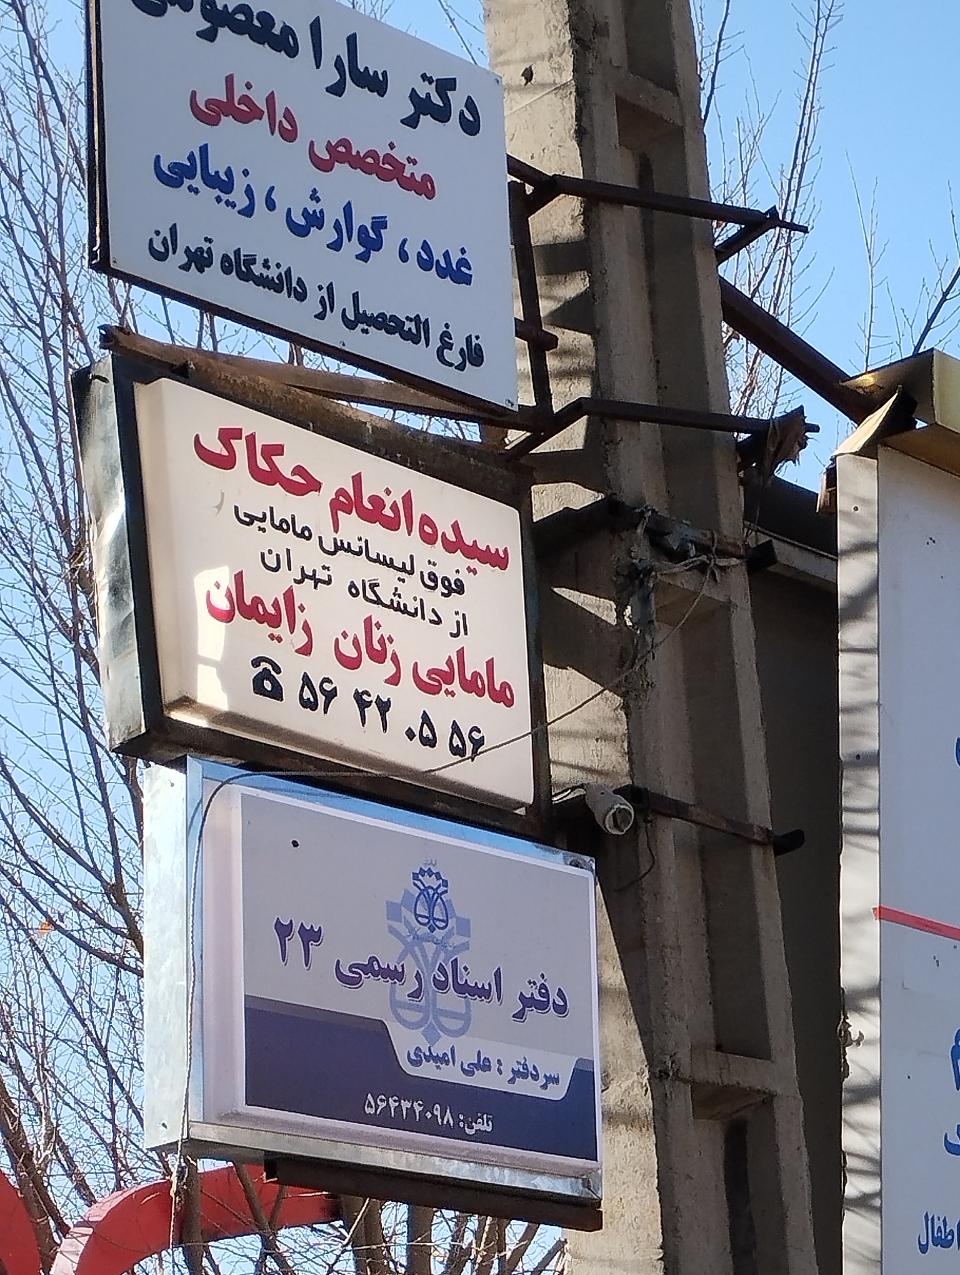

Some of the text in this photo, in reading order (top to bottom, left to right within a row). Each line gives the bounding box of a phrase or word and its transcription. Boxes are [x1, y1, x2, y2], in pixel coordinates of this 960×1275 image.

[310, 16, 388, 97] سارا
[190, 73, 436, 200] متخصص داخلی
[401, 73, 480, 136] دکتر
[154, 143, 255, 218] زیبایی
[148, 223, 484, 371] فارغ التحصیل از دانشگاه تهران
[194, 427, 509, 575] سیده انعام حکاک
[233, 502, 465, 596] فوق لیسانس مامایی
[260, 548, 469, 640] از دانشگاه تهران
[206, 570, 515, 708] مامایی زنان زایمان
[273, 916, 569, 1022] دفتر اسناد رسمی ۲۳
[407, 1045, 455, 1070] امیدی
[461, 1049, 492, 1077] علی
[364, 1092, 454, 1128] ۵۶۴۳۴۰۹۸
[917, 1211, 960, 1254] اطفال
